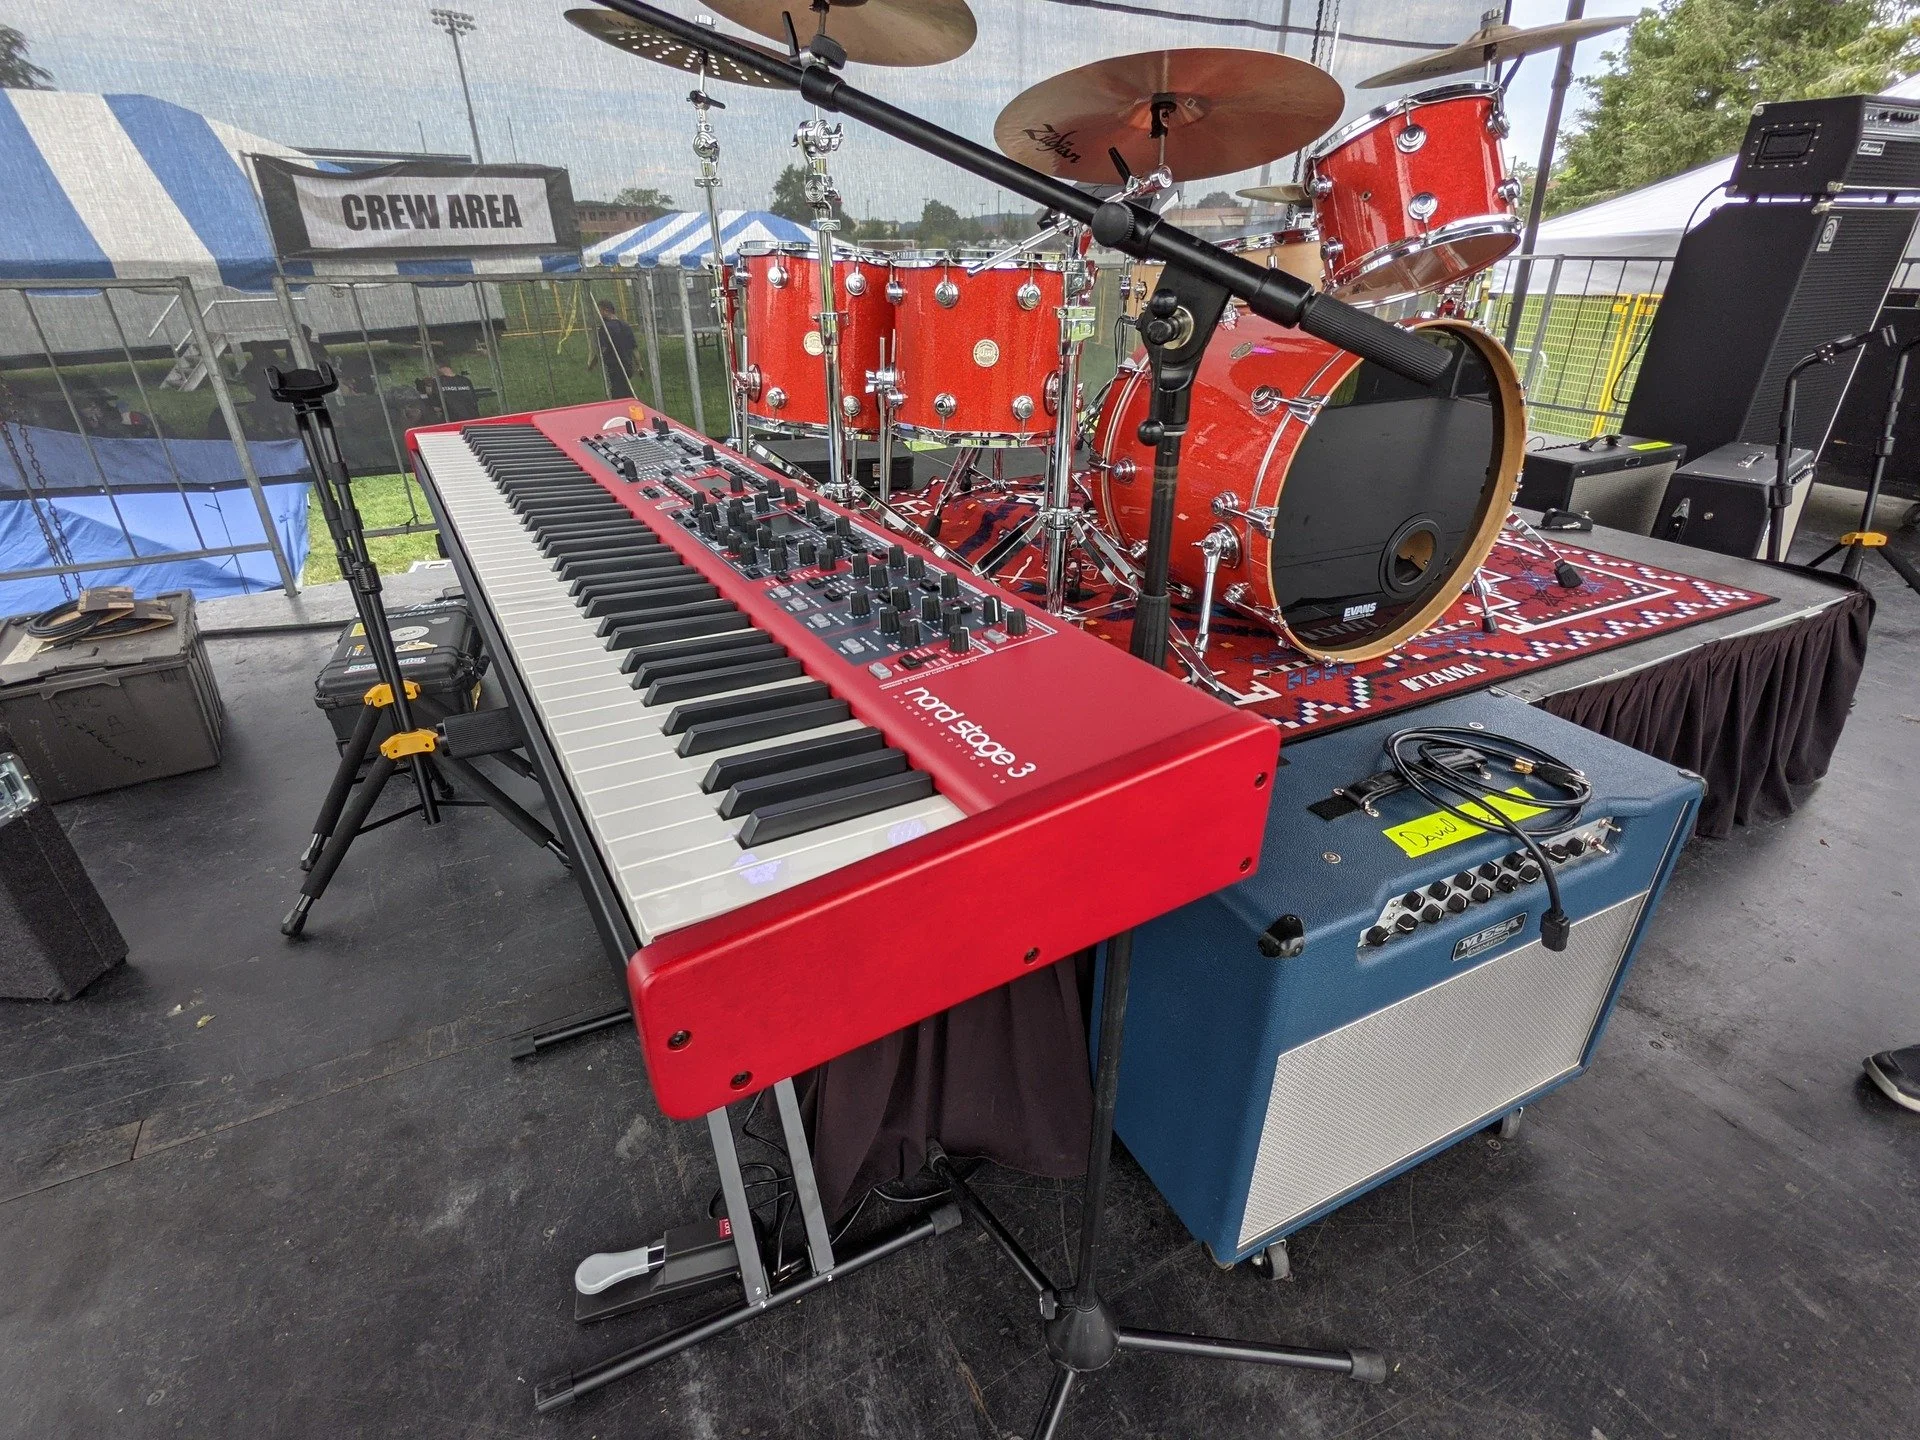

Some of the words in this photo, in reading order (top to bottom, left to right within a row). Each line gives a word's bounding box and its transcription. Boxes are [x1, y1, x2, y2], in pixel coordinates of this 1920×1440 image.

[341, 193, 441, 231] CREW
[446, 194, 523, 229] AREA
[386, 610, 436, 619] ELICAN
[1343, 602, 1377, 618] EVANS
[1411, 662, 1487, 688] TAMA
[905, 686, 965, 723] nord
[948, 720, 1016, 766] stage
[1007, 762, 1037, 778] 3
[1398, 817, 1457, 848] David
[1461, 918, 1520, 951] MESA
